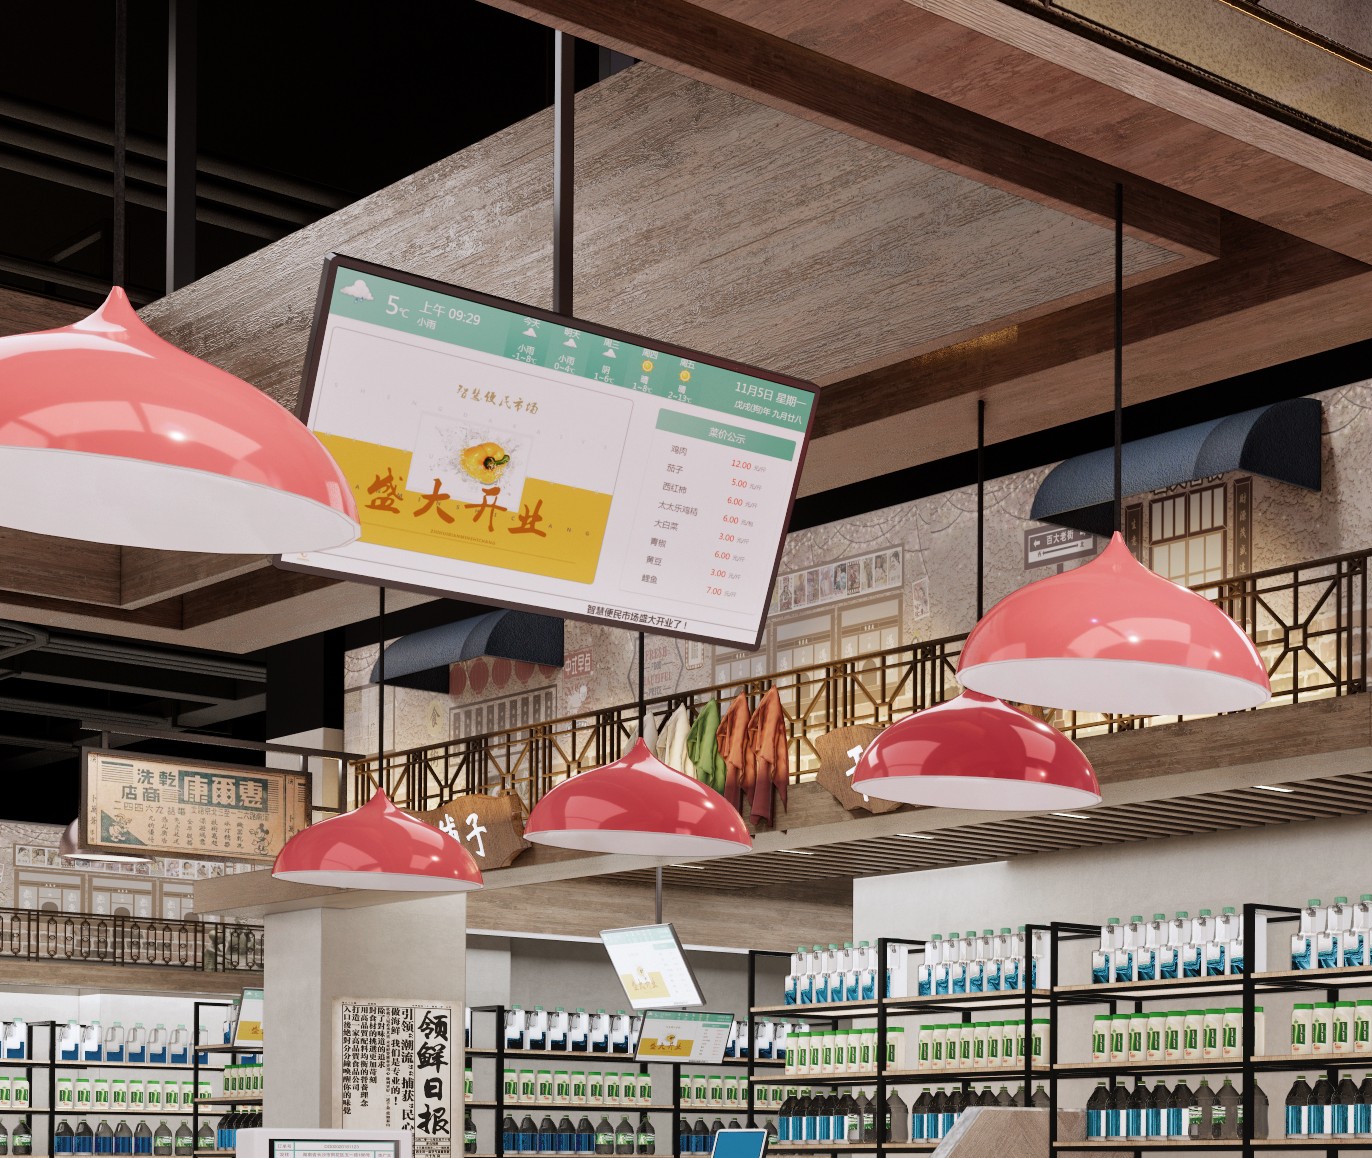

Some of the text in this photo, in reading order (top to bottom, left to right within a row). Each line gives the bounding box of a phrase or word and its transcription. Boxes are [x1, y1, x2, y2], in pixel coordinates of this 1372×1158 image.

[416, 317, 437, 330] 小雨
[418, 301, 481, 326] 上午 09:29
[523, 317, 541, 328] 今天
[564, 328, 581, 339] 明天
[518, 343, 535, 355] 小雨
[558, 354, 575, 366] 小雨
[735, 381, 807, 408] 11月5日 星期一
[708, 427, 746, 444] 菜价公示
[671, 444, 752, 470] 鸡肉 12.00
[667, 463, 747, 489] 茄子 5.00
[364, 466, 548, 538] 盛大开业
[662, 482, 743, 507] 西红柿 6.00
[654, 519, 734, 543] 大白菜 3.00
[723, 515, 739, 525] 6.00
[650, 537, 730, 561] 青椒 6.00
[710, 568, 726, 579] 3.00
[706, 586, 722, 597] 7.00
[391, 1008, 400, 1035] 做海鲜
[417, 1011, 449, 1135] 领鲜日报
